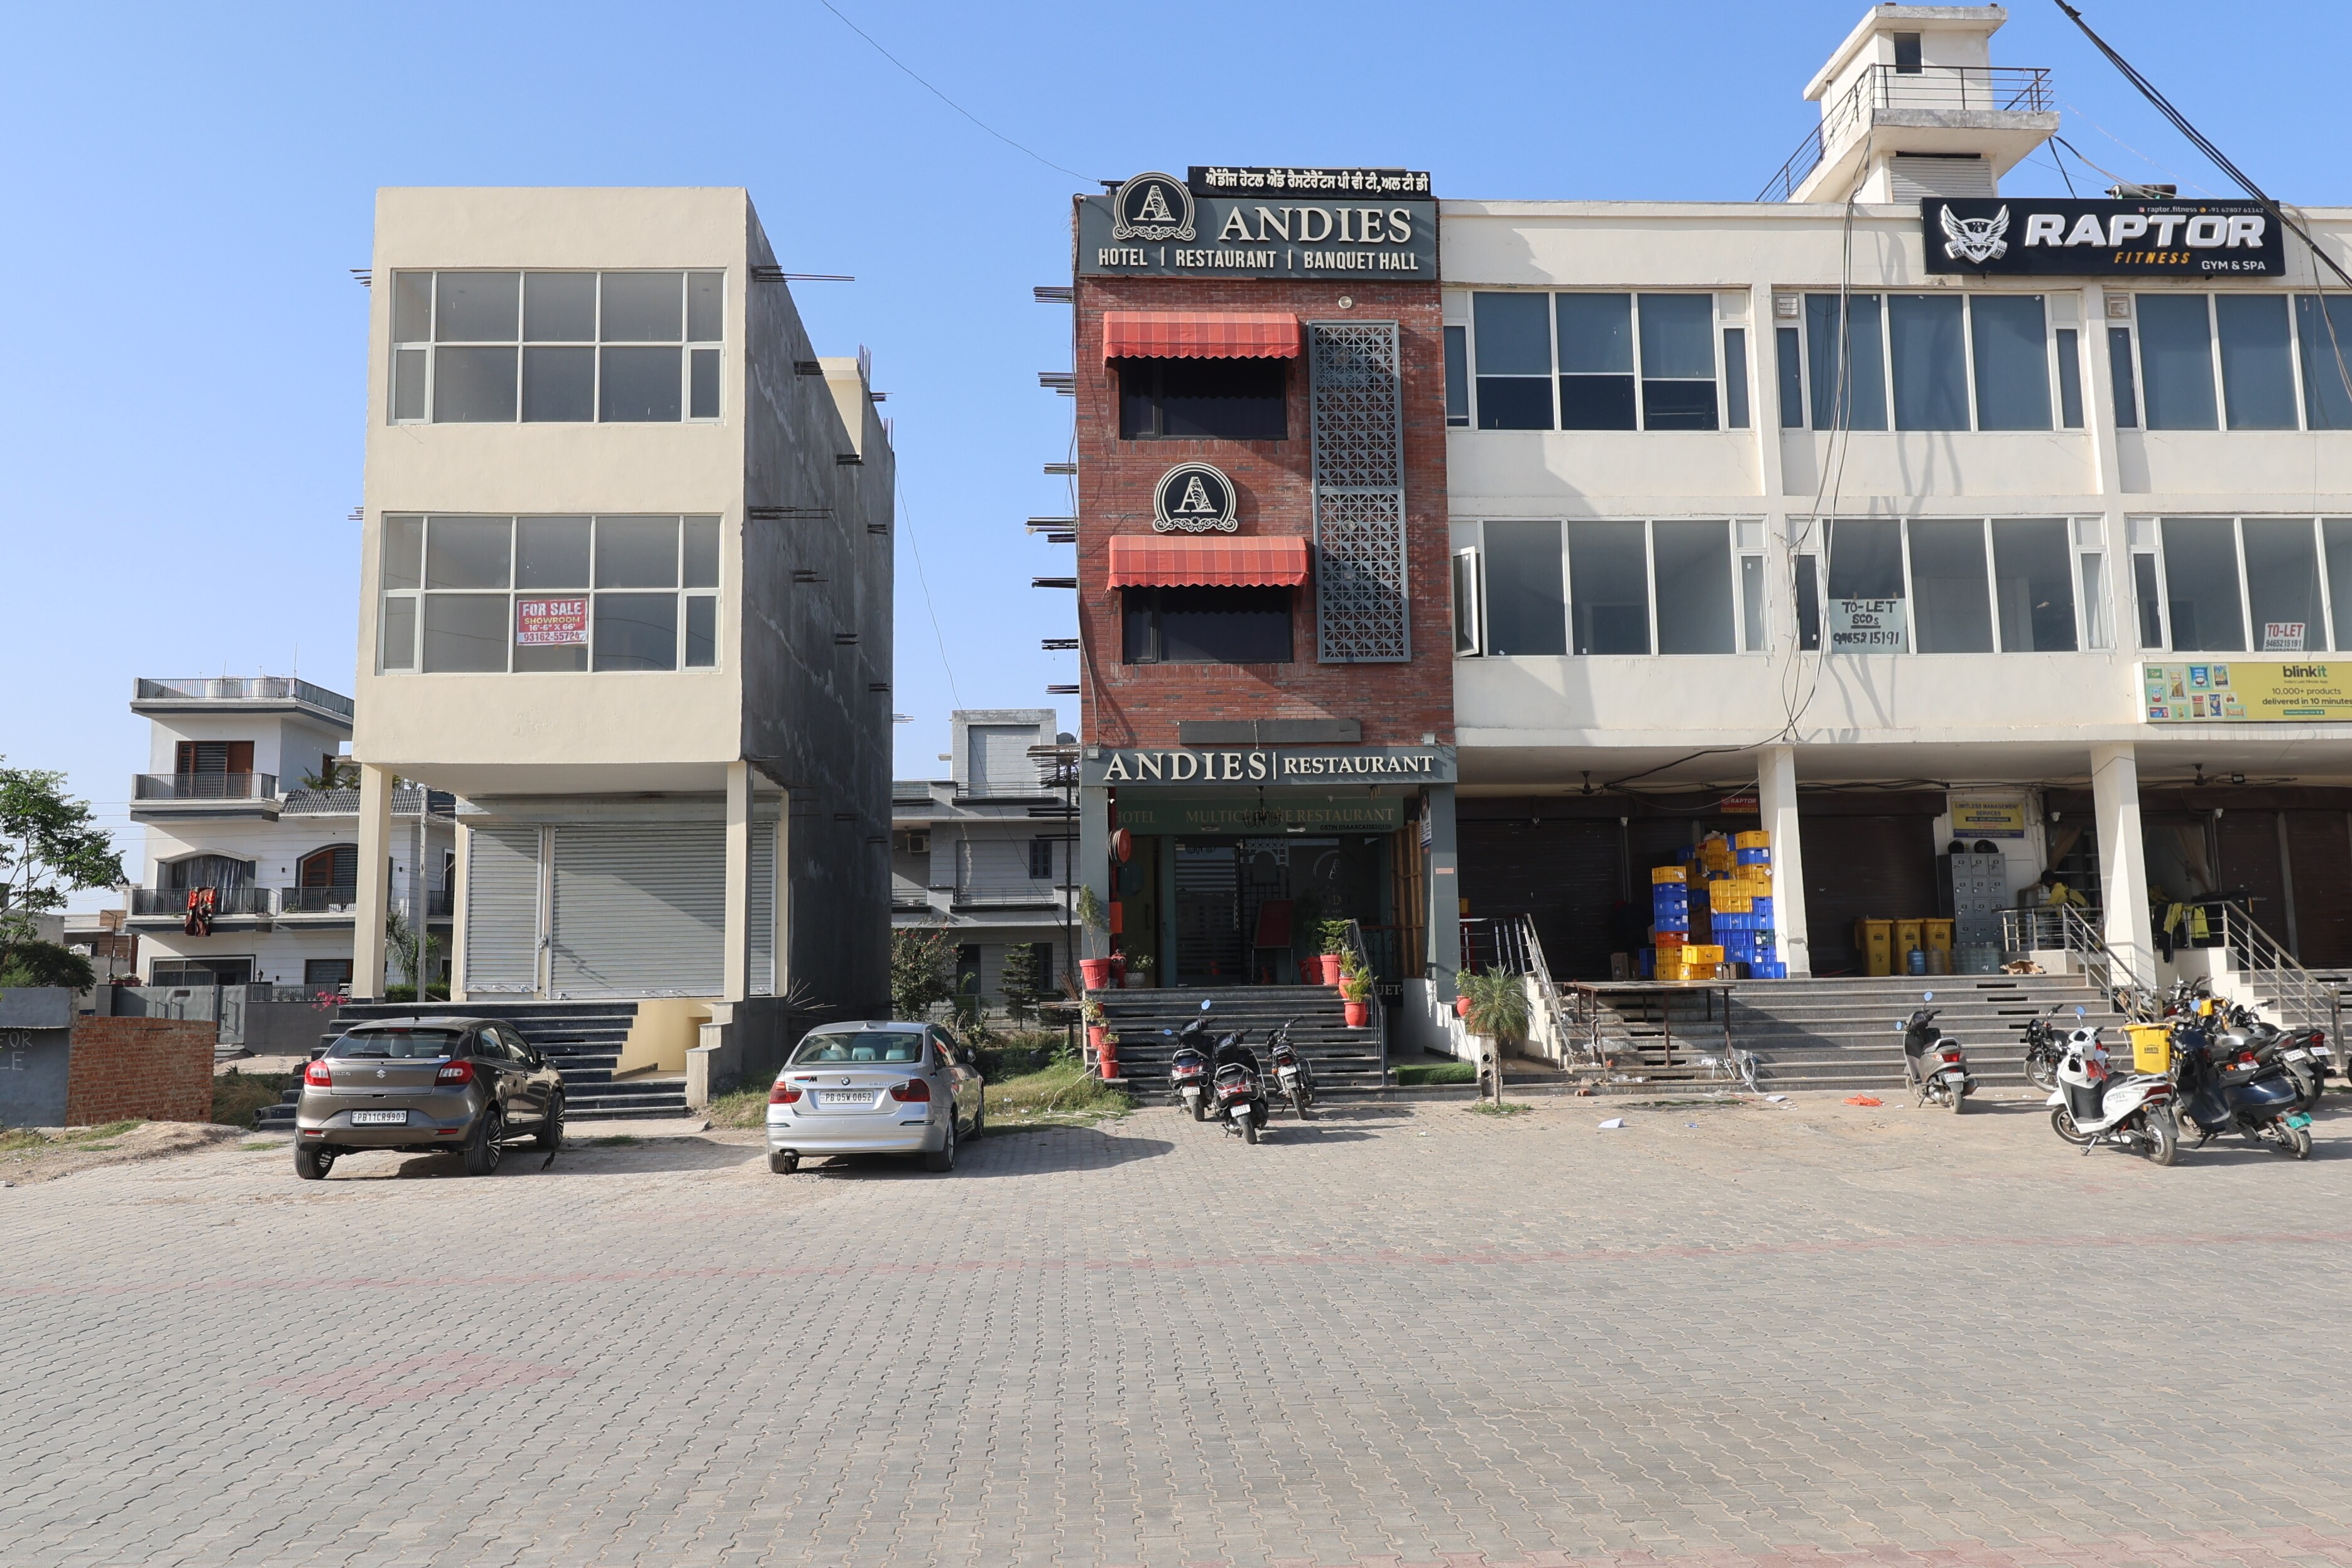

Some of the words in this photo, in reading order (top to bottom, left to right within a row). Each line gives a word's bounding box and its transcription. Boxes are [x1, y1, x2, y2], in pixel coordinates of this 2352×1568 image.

[1239, 168, 1264, 187] ਹੋਟਲ
[1337, 171, 1350, 189] ਪੀ
[1351, 171, 1363, 190] ਵੀ
[1402, 173, 1414, 191] ਟੀ
[1416, 173, 1429, 191] ਡੀ
[1218, 206, 1412, 243] ANDIES
[2025, 214, 2265, 248] RAPTOR
[1099, 248, 1148, 266] HOTEL
[1176, 249, 1276, 268] RESTAURANT
[1304, 251, 1375, 270] BANQUET
[1380, 253, 1418, 270] HALL
[2115, 252, 2191, 264] FITNESS
[2201, 261, 2228, 270] GYM
[2231, 261, 2240, 270] &
[2243, 261, 2266, 270] SPA
[523, 603, 546, 616] FOR
[550, 602, 582, 616] SALE
[1842, 601, 1897, 614] TO-LET
[525, 616, 580, 624] SHOWROOM
[524, 631, 580, 641] 93162-55724
[2267, 624, 2304, 638] TO-LET
[2266, 640, 2302, 648] 9465215191
[2282, 665, 2328, 678] blinkit
[1103, 751, 1266, 780] ANDIES
[1283, 756, 1434, 775] RESTAURANT
[1297, 808, 1395, 822] RESTAURANT
[852, 1093, 871, 1101] 0052
[357, 1113, 405, 1121] PB11CR9903
